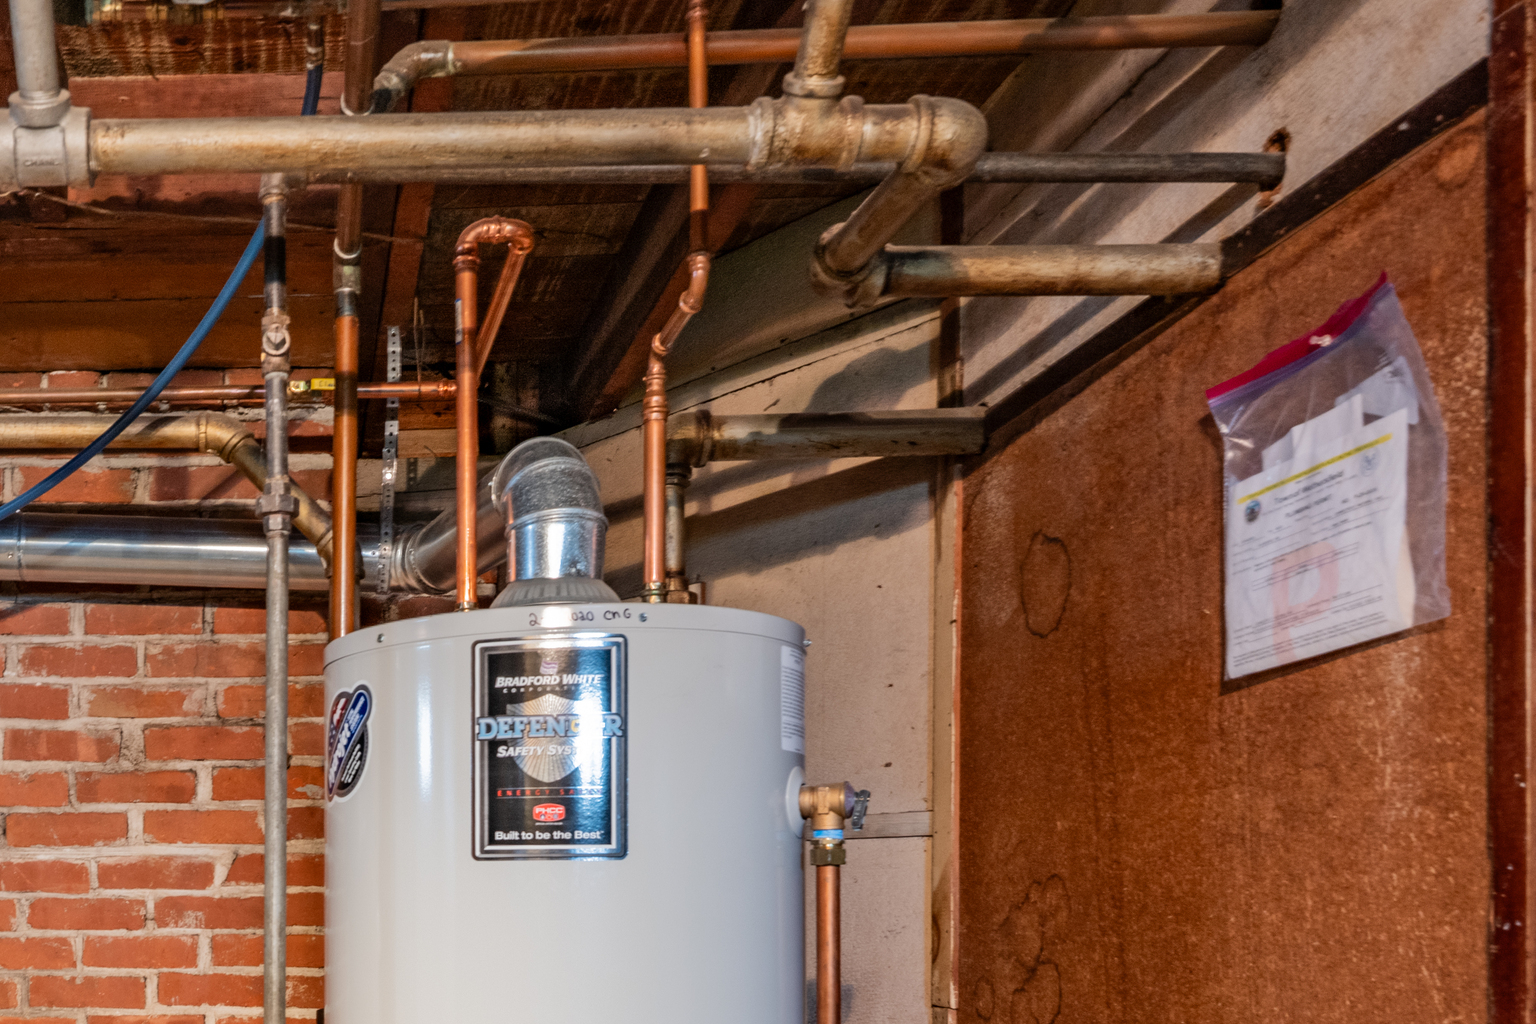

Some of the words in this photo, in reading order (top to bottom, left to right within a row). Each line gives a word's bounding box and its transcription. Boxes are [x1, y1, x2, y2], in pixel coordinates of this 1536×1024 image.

[495, 675, 560, 688] BRADFORD
[562, 673, 604, 685] WHITE
[496, 746, 545, 757] SAFETY
[497, 789, 550, 797] ENERGY
[495, 830, 519, 840] Built
[521, 832, 534, 840] to
[536, 831, 550, 839] be
[553, 830, 572, 839] the
